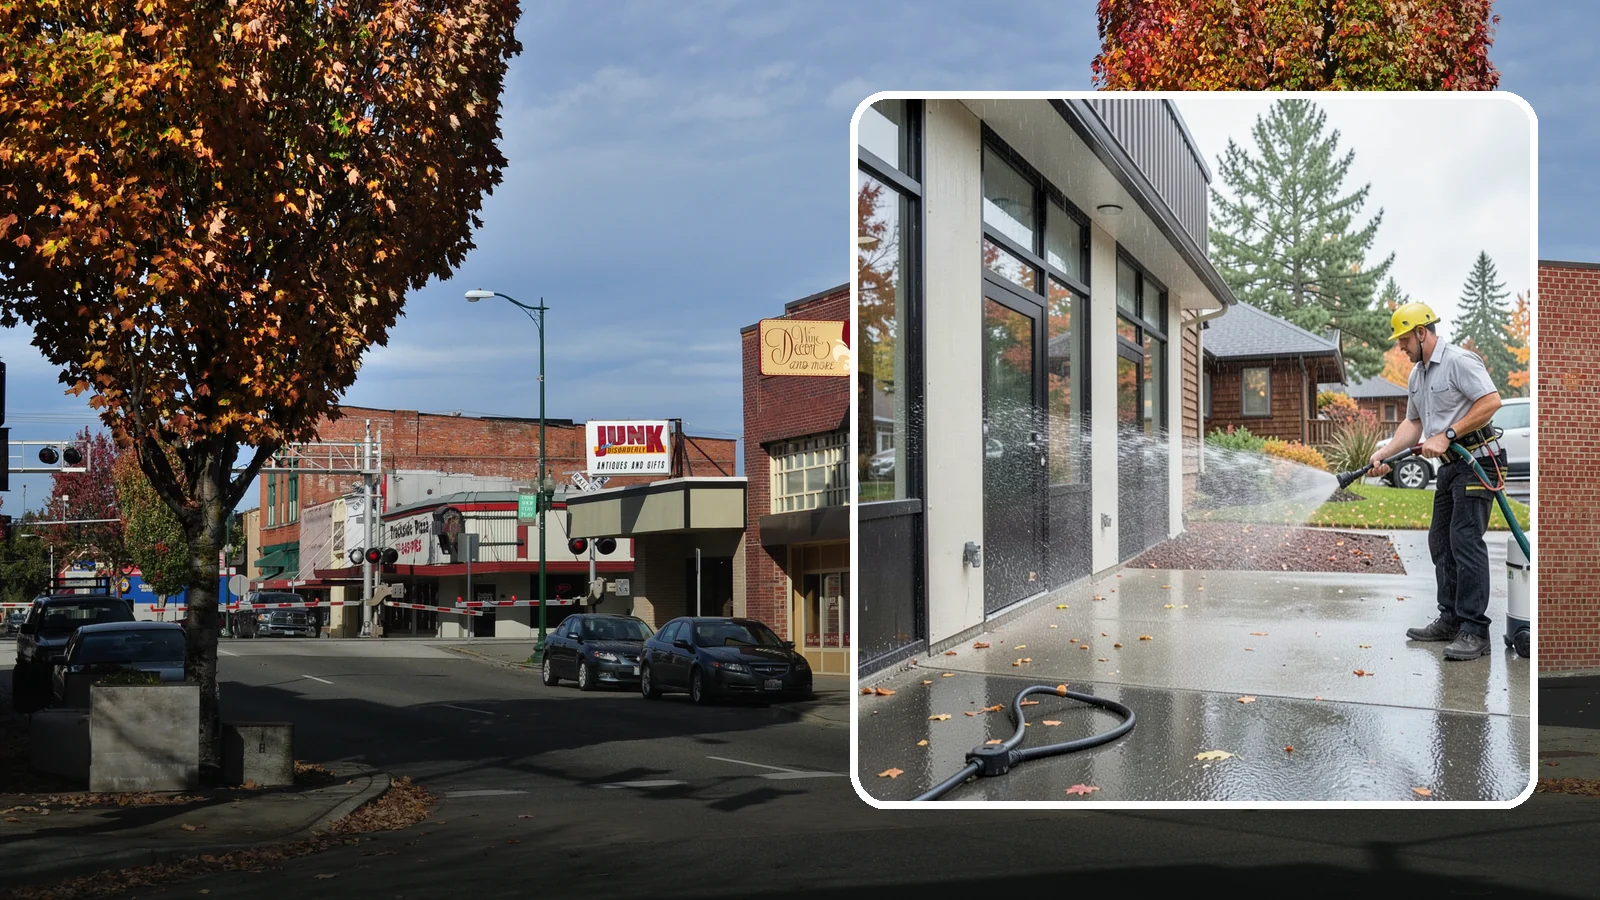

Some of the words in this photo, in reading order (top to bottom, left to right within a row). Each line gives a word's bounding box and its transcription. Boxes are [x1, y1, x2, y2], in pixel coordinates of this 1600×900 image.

[595, 425, 665, 457] JUNK
[607, 446, 646, 454] DISORDERLY
[597, 461, 628, 470] ANTIQUES
[631, 461, 644, 470] AND
[647, 461, 665, 469] GIFTS
[390, 521, 413, 540] Trackside
[414, 519, 429, 534] Pizza
